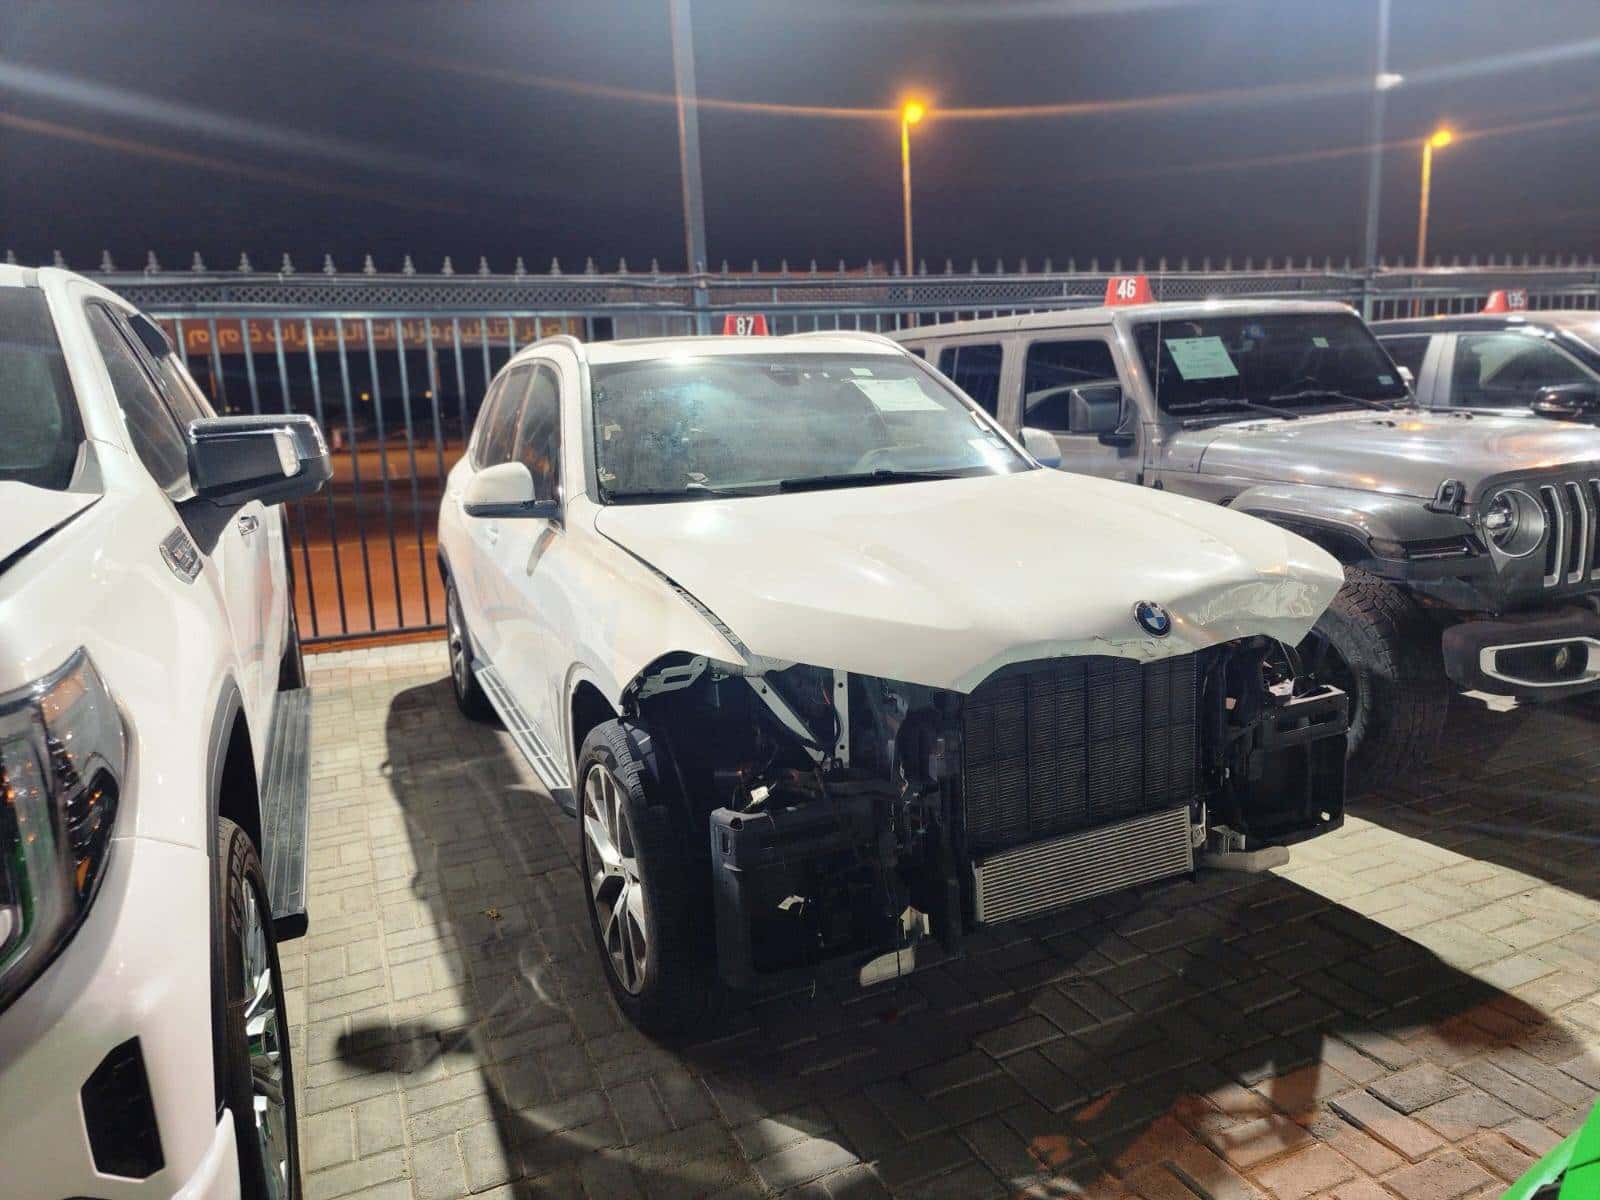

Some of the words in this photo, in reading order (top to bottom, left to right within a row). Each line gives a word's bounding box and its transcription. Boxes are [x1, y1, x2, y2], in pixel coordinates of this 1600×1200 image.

[1116, 278, 1137, 299] 46
[264, 321, 364, 347] السيرات
[735, 316, 754, 336] 87
